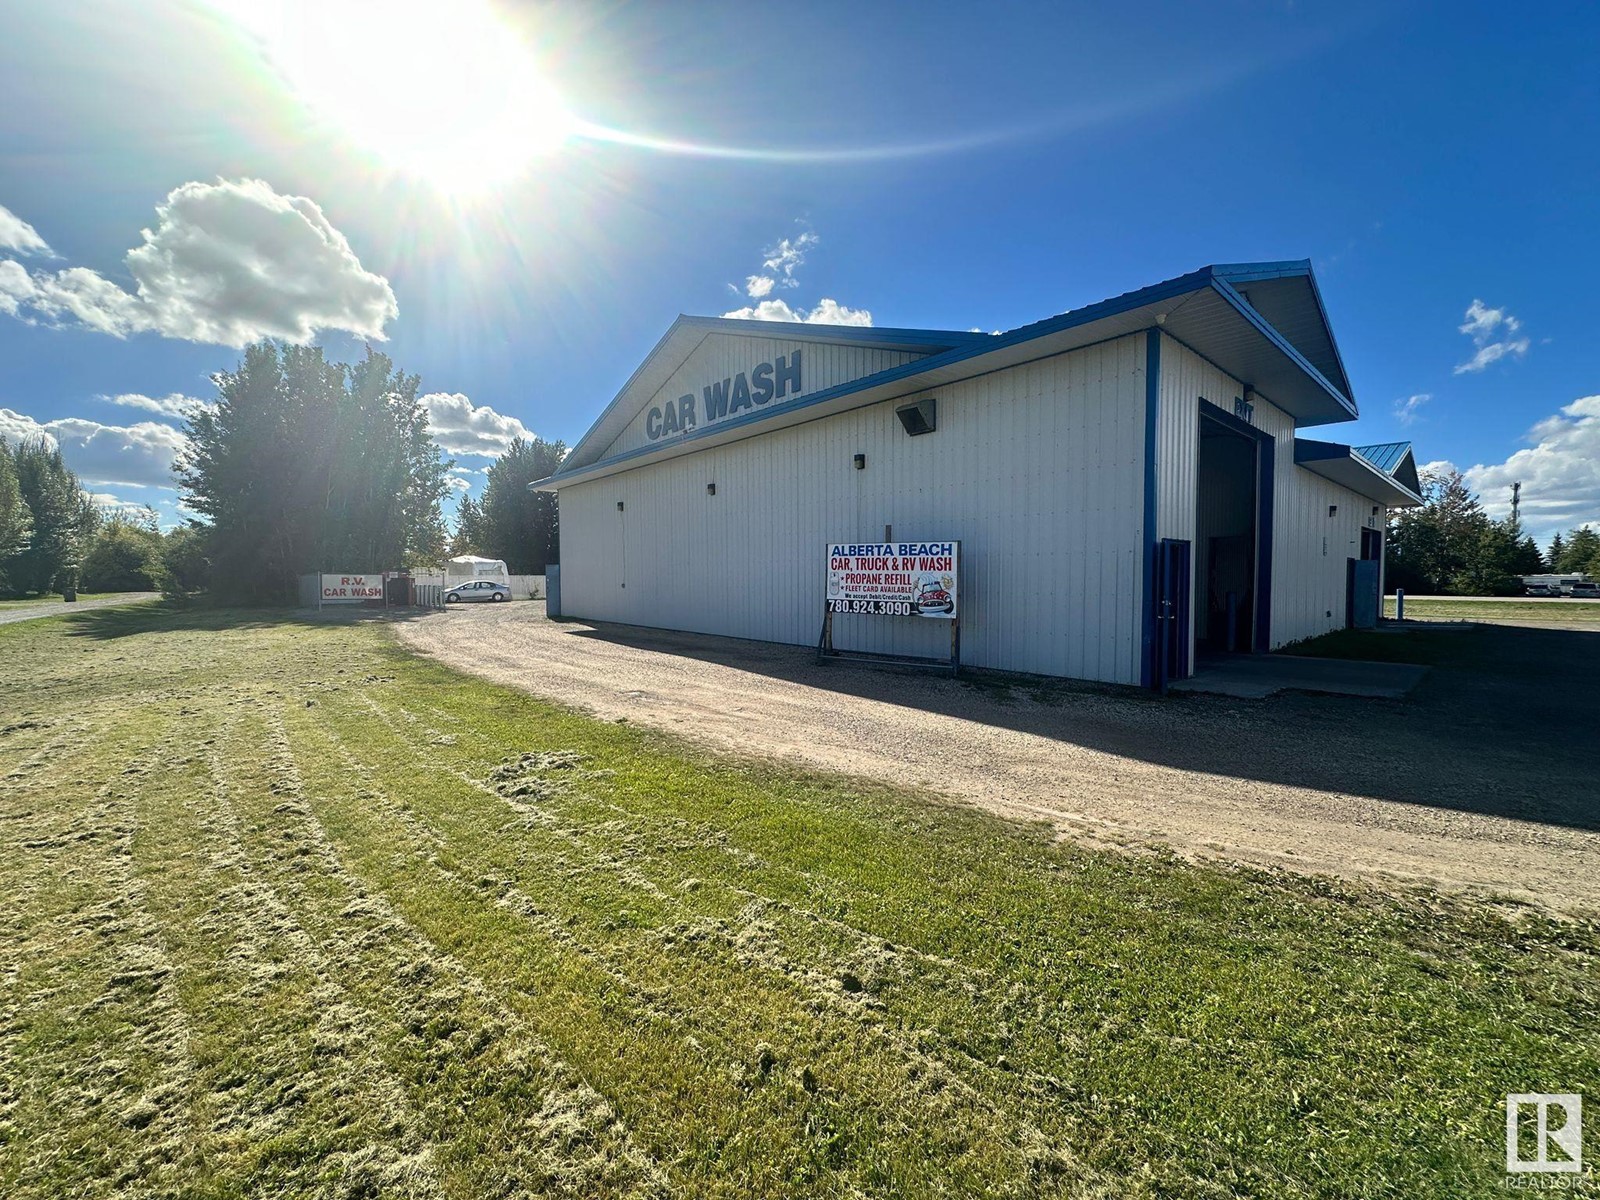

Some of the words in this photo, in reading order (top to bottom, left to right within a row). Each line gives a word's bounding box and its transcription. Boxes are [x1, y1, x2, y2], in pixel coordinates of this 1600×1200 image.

[646, 393, 696, 440] CAR
[703, 349, 801, 421] WASH
[831, 545, 894, 556] ALBERTA
[899, 543, 952, 556] BEACH
[831, 558, 853, 571] CAR,
[855, 558, 889, 571] TRUCK
[892, 558, 899, 571] &
[902, 558, 916, 571] RV
[919, 557, 952, 571] WASH
[341, 577, 365, 585] R.V.
[845, 573, 882, 584] PROPANE
[884, 573, 912, 585] REFILL
[324, 588, 346, 596] CAR
[351, 588, 381, 596] WASH
[829, 600, 910, 615] 780.924.3090
